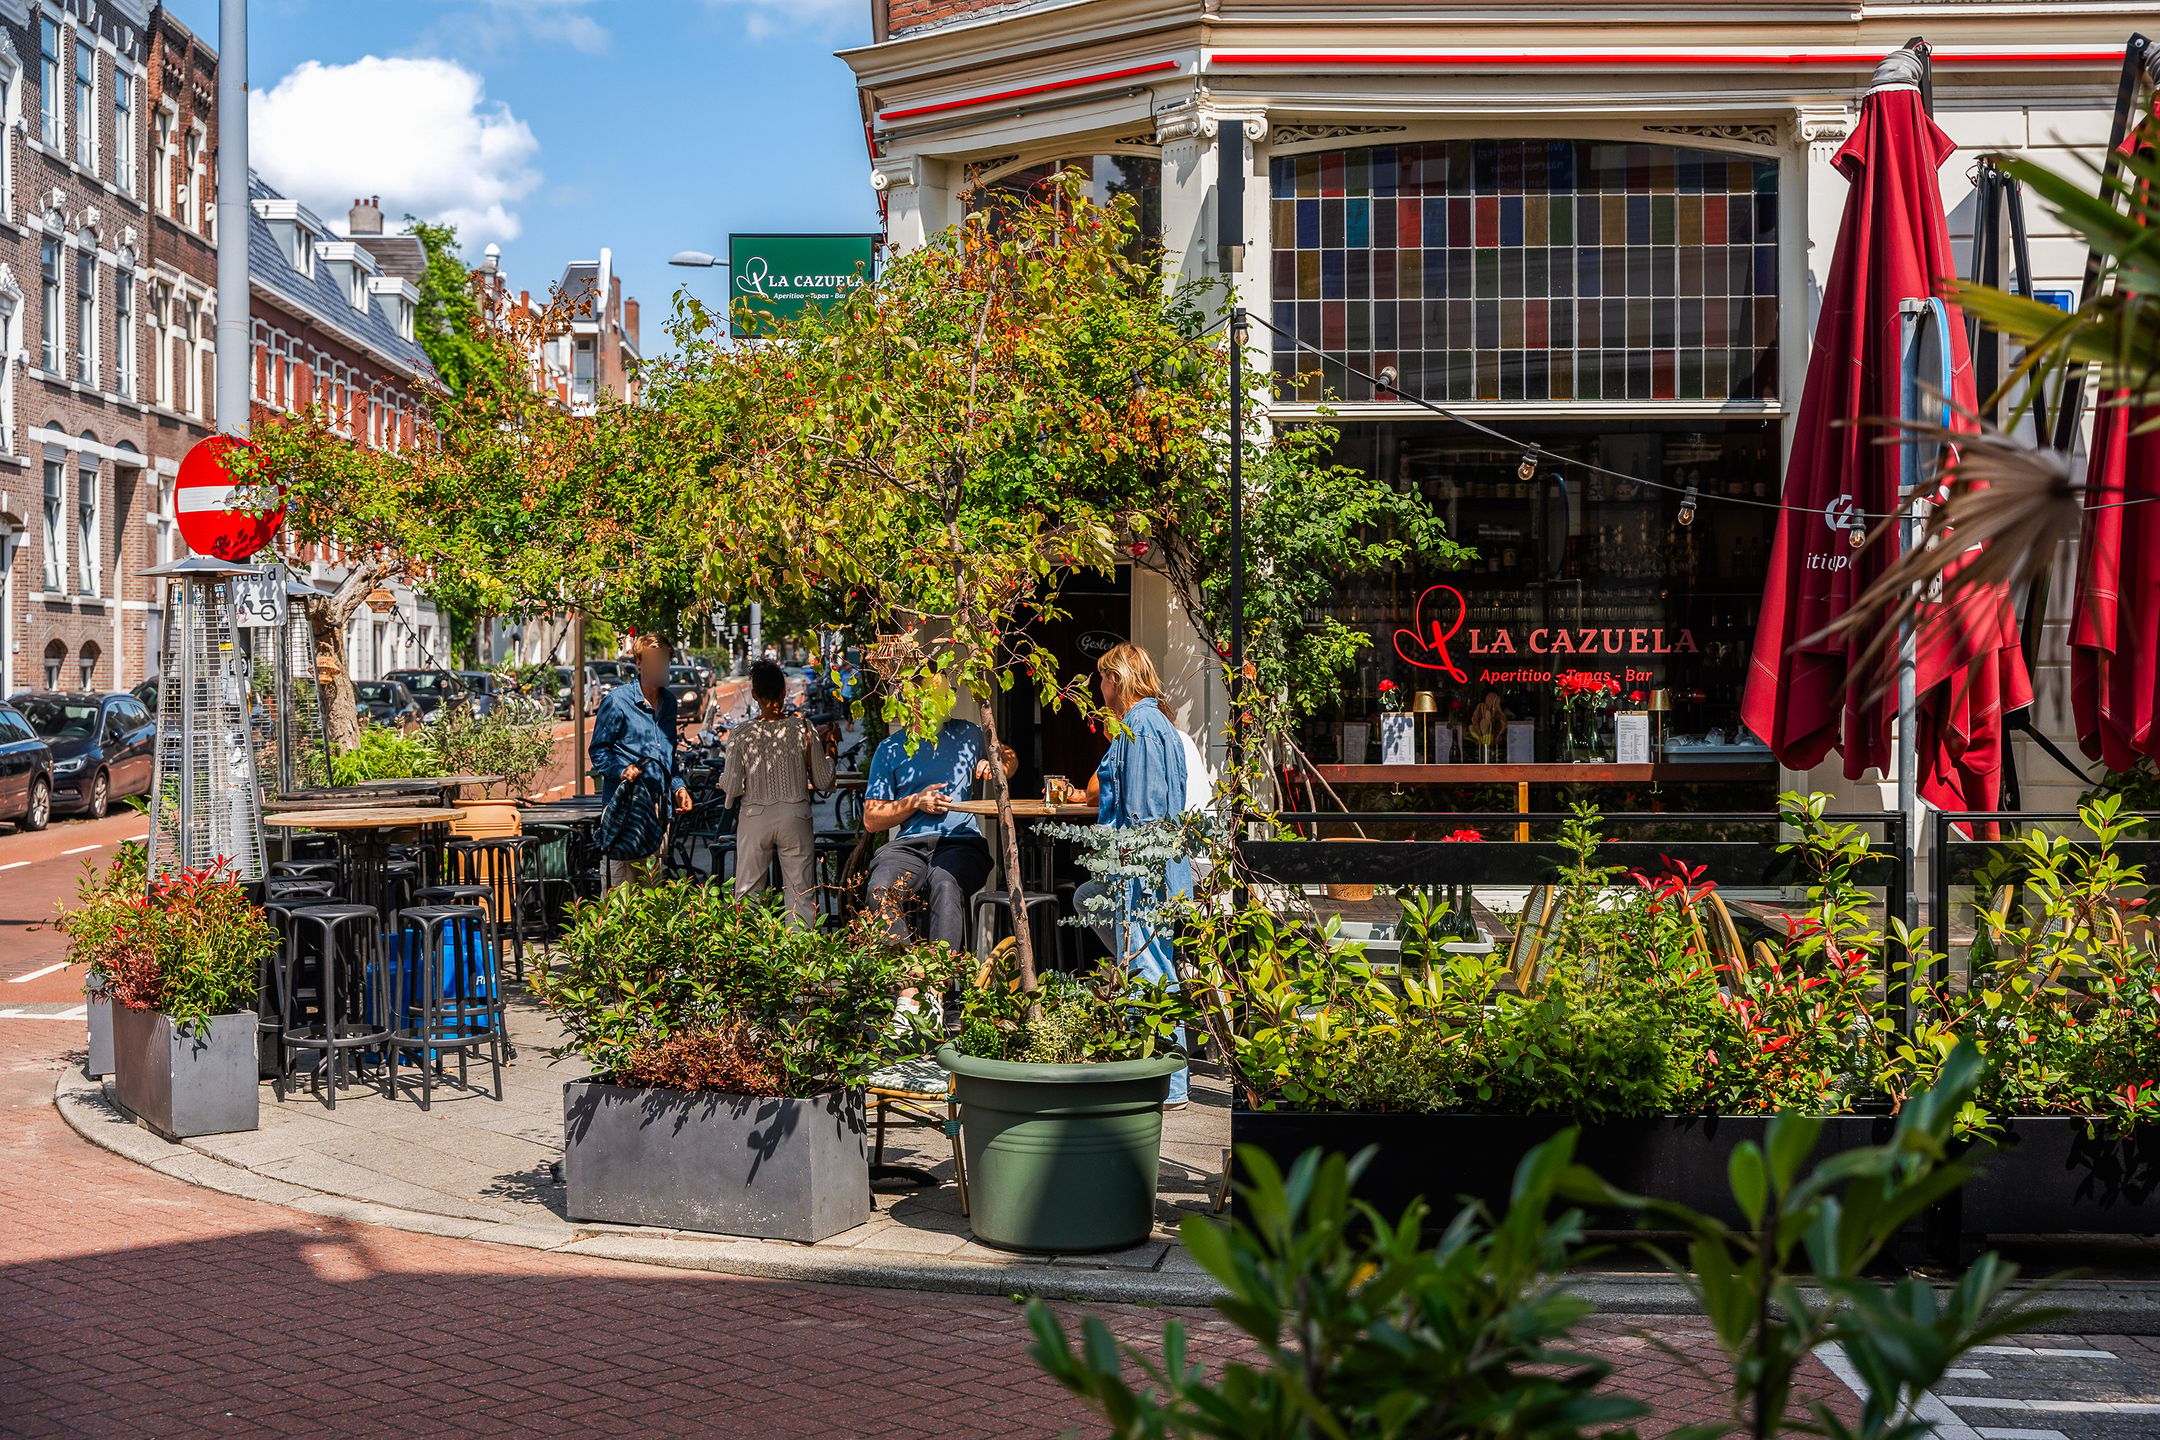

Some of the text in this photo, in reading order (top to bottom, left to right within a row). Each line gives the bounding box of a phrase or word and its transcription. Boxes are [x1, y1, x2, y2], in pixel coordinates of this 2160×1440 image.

[768, 275, 865, 287] LA CAZUELA
[810, 292, 829, 300] Tapas
[1081, 635, 1115, 650] Geslot
[1469, 629, 1699, 653] LA CAZUELA
[1480, 669, 1551, 684] Aperitivo
[1566, 669, 1611, 684] Tapas
[1626, 669, 1653, 682] Bar
